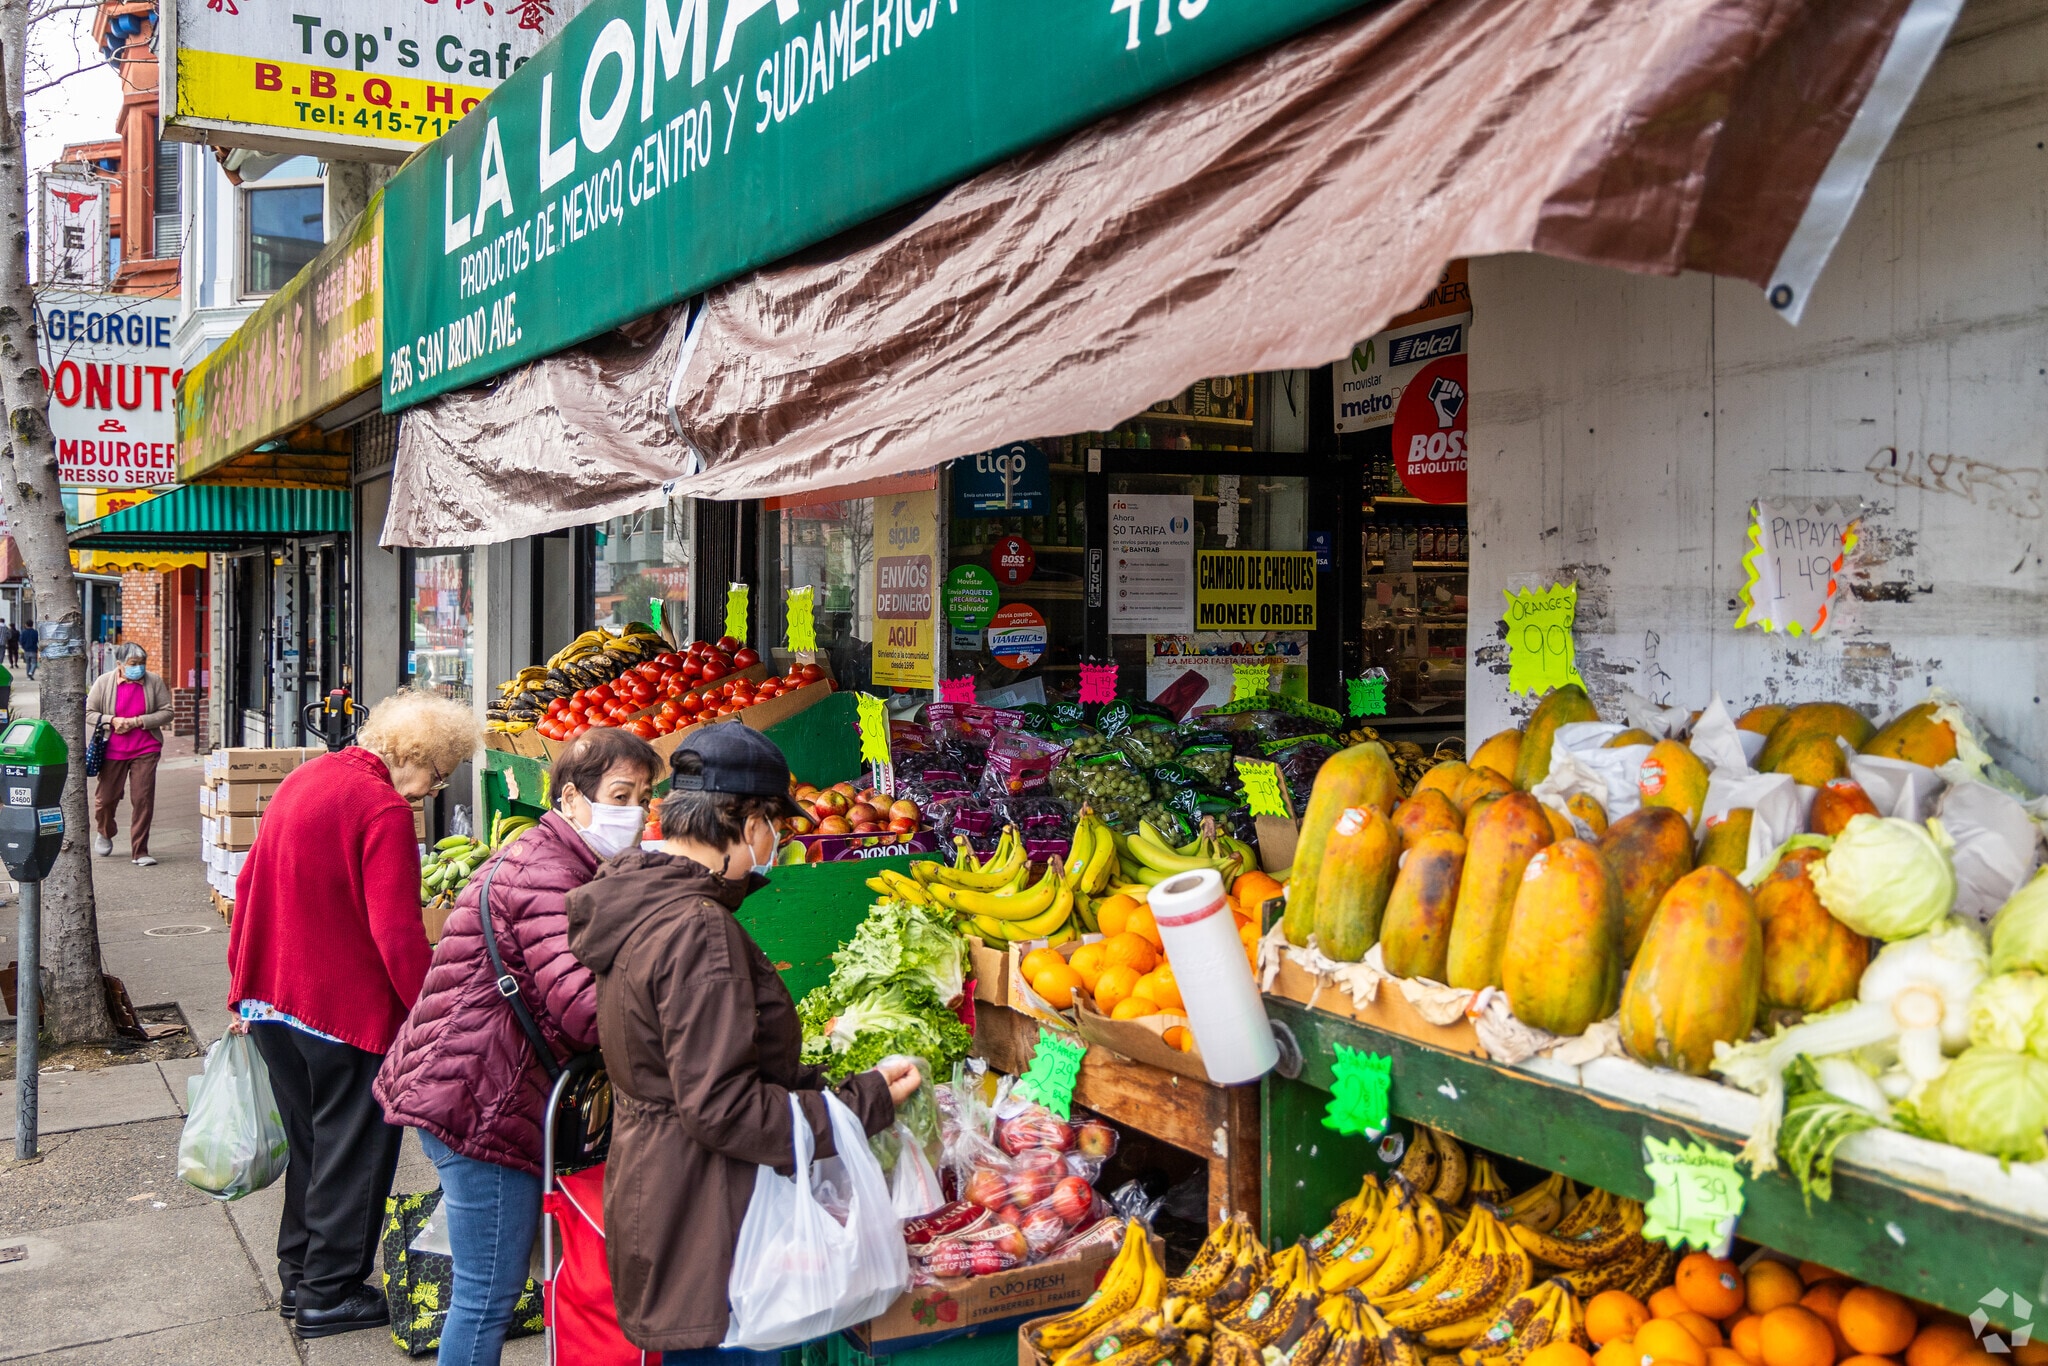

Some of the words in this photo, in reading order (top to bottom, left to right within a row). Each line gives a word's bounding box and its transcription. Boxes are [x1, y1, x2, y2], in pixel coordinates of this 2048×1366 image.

[293, 14, 419, 71] Top's
[255, 62, 410, 109] B.B.Q.
[295, 102, 345, 126] Tel:
[445, 116, 514, 255] LA
[461, 220, 531, 299] PRODUCTOS
[536, 202, 556, 262] DE
[561, 159, 623, 247] MEXICO,
[629, 100, 712, 207] CENTRO
[723, 75, 744, 155] Y
[390, 344, 412, 396] 2456
[417, 326, 445, 381] SAN
[448, 306, 486, 370] BRUNO
[488, 292, 522, 353] AVE.
[1410, 329, 1459, 360] telcel
[1342, 374, 1382, 392] movistar
[98, 419, 127, 433] &
[1113, 500, 1127, 510] ria
[889, 523, 920, 550] sigue
[1113, 525, 1127, 536] $0
[1129, 526, 1167, 536] TARIFA
[1771, 516, 1844, 550] PAPAYA
[1001, 555, 1025, 564] BOSS
[881, 560, 928, 588] ENVÍOS
[1091, 553, 1100, 593] PUSH
[1200, 555, 1245, 590] CAMBIO
[1248, 556, 1262, 590] DE
[1264, 555, 1314, 594] CHEQUES
[878, 594, 890, 612] DE
[892, 593, 931, 612] DINERO
[958, 603, 989, 612] Salvador
[1200, 603, 1257, 624] MONEY
[1260, 603, 1313, 624] ORDER
[1512, 596, 1573, 620] ORANGES
[889, 622, 917, 647] AQUÍ
[853, 843, 910, 859] NORDIC
[990, 1281, 1024, 1299] EXPO
[1026, 1273, 1065, 1291] FRESH
[972, 1298, 1035, 1318] STRAWBERRIES
[1047, 1290, 1082, 1303] FRAISES
